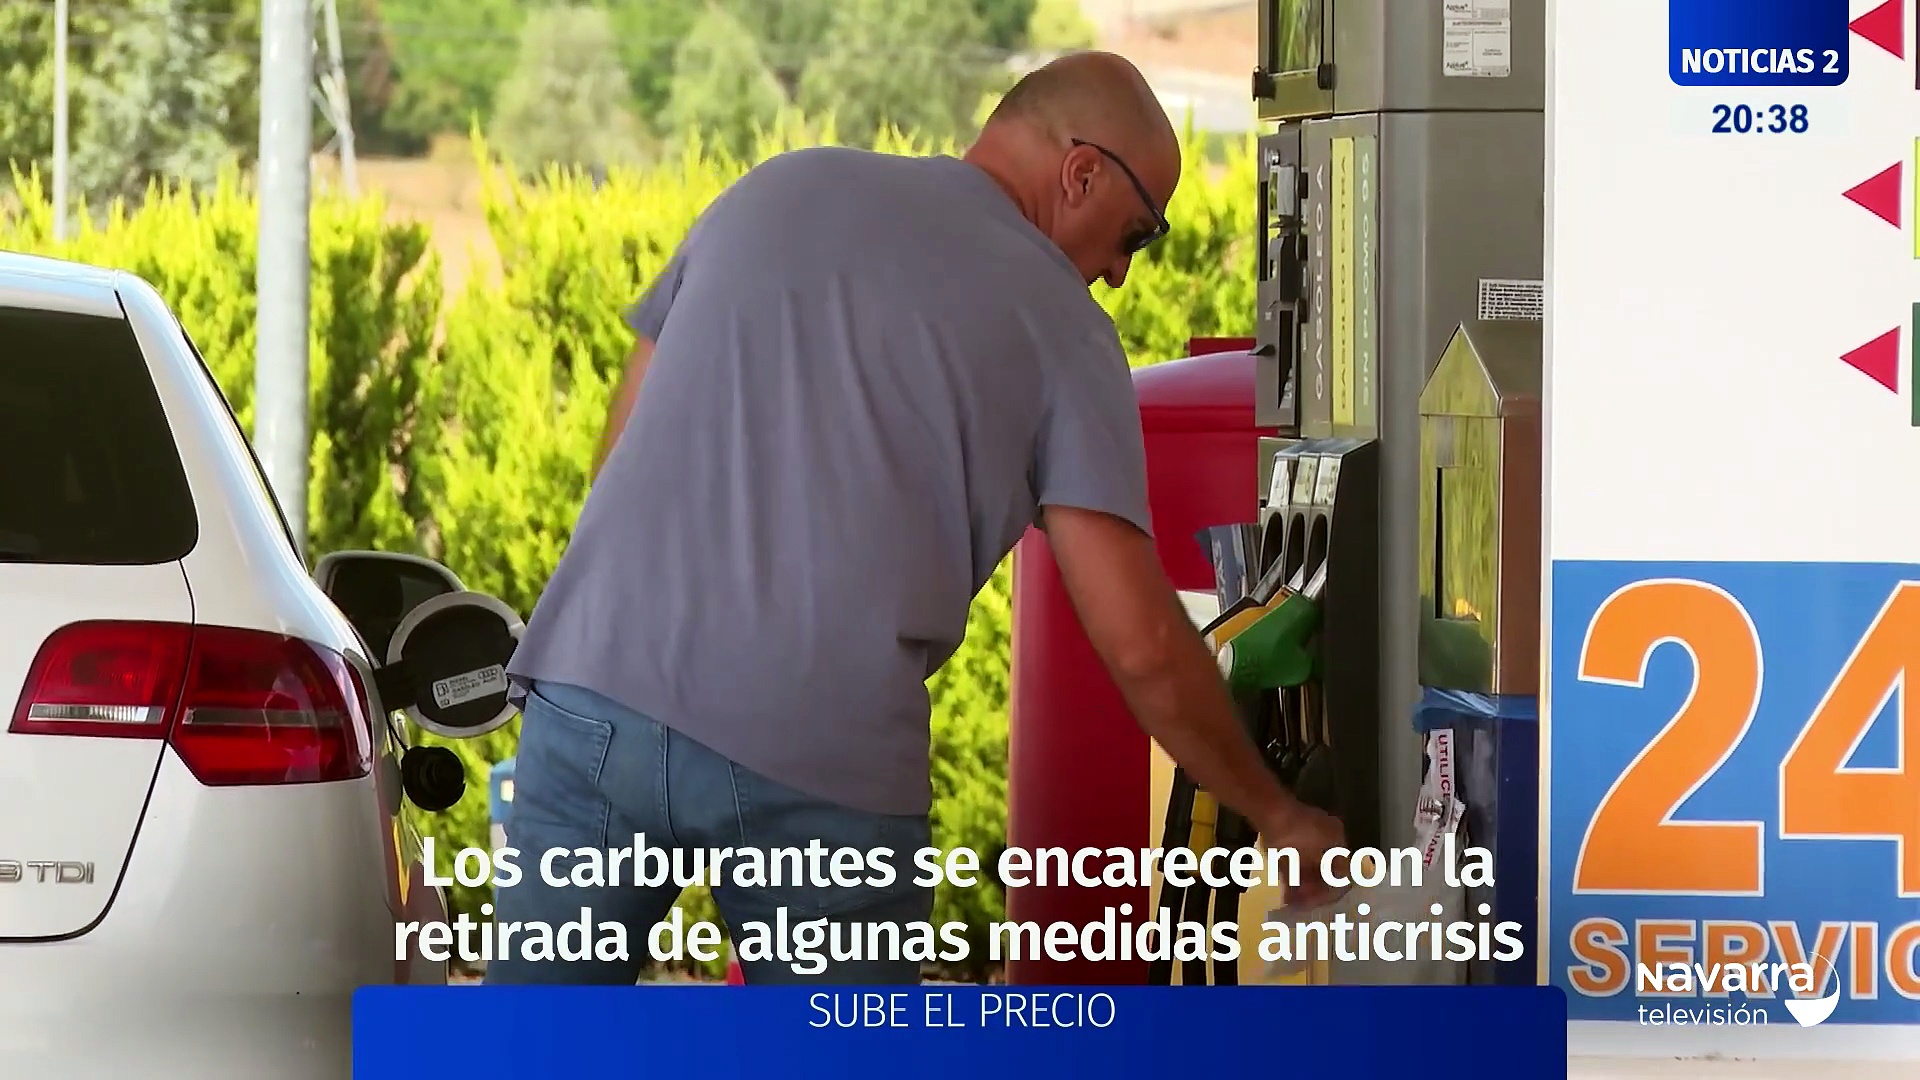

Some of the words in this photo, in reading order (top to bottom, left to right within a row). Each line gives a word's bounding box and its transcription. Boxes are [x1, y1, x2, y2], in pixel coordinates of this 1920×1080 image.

[1316, 164, 1323, 192] A
[1362, 152, 1369, 203] 95
[1315, 202, 1323, 400] GASOLEO
[1573, 577, 1920, 897] 24
[27, 861, 94, 884] TDI
